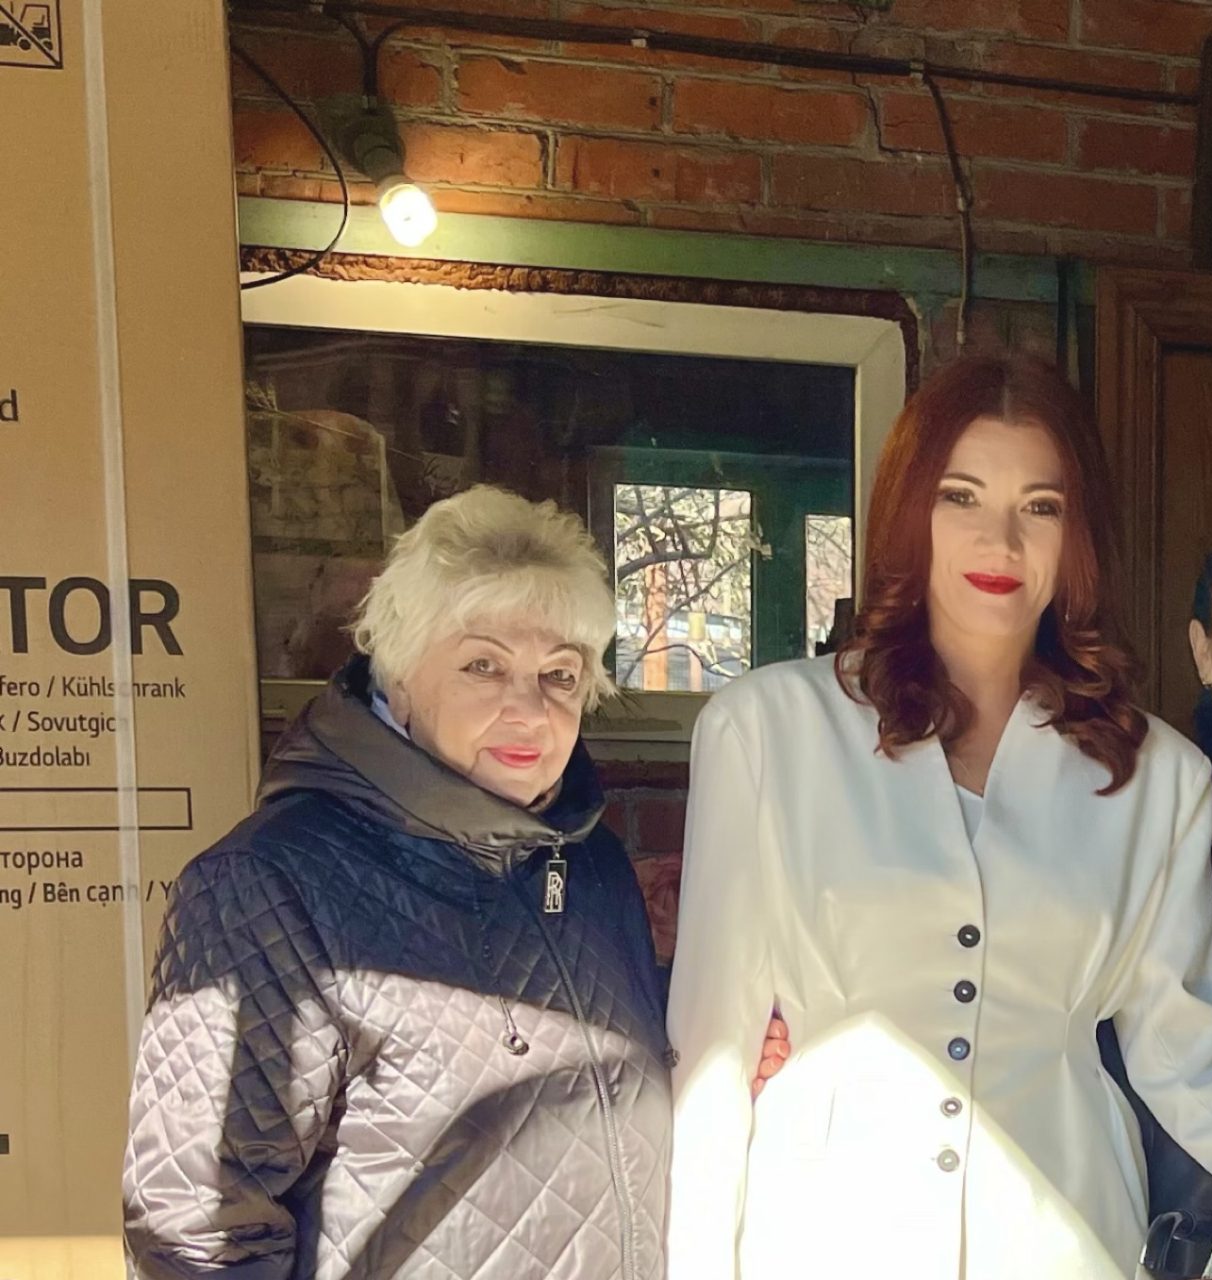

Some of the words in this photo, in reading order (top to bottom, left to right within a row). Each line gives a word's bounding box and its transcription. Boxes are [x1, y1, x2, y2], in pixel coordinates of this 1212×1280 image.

[62, 676, 186, 698] Kühlshrank
[27, 711, 126, 738] Sovutgic
[43, 882, 81, 903] Bên
[86, 879, 138, 908] cạn
